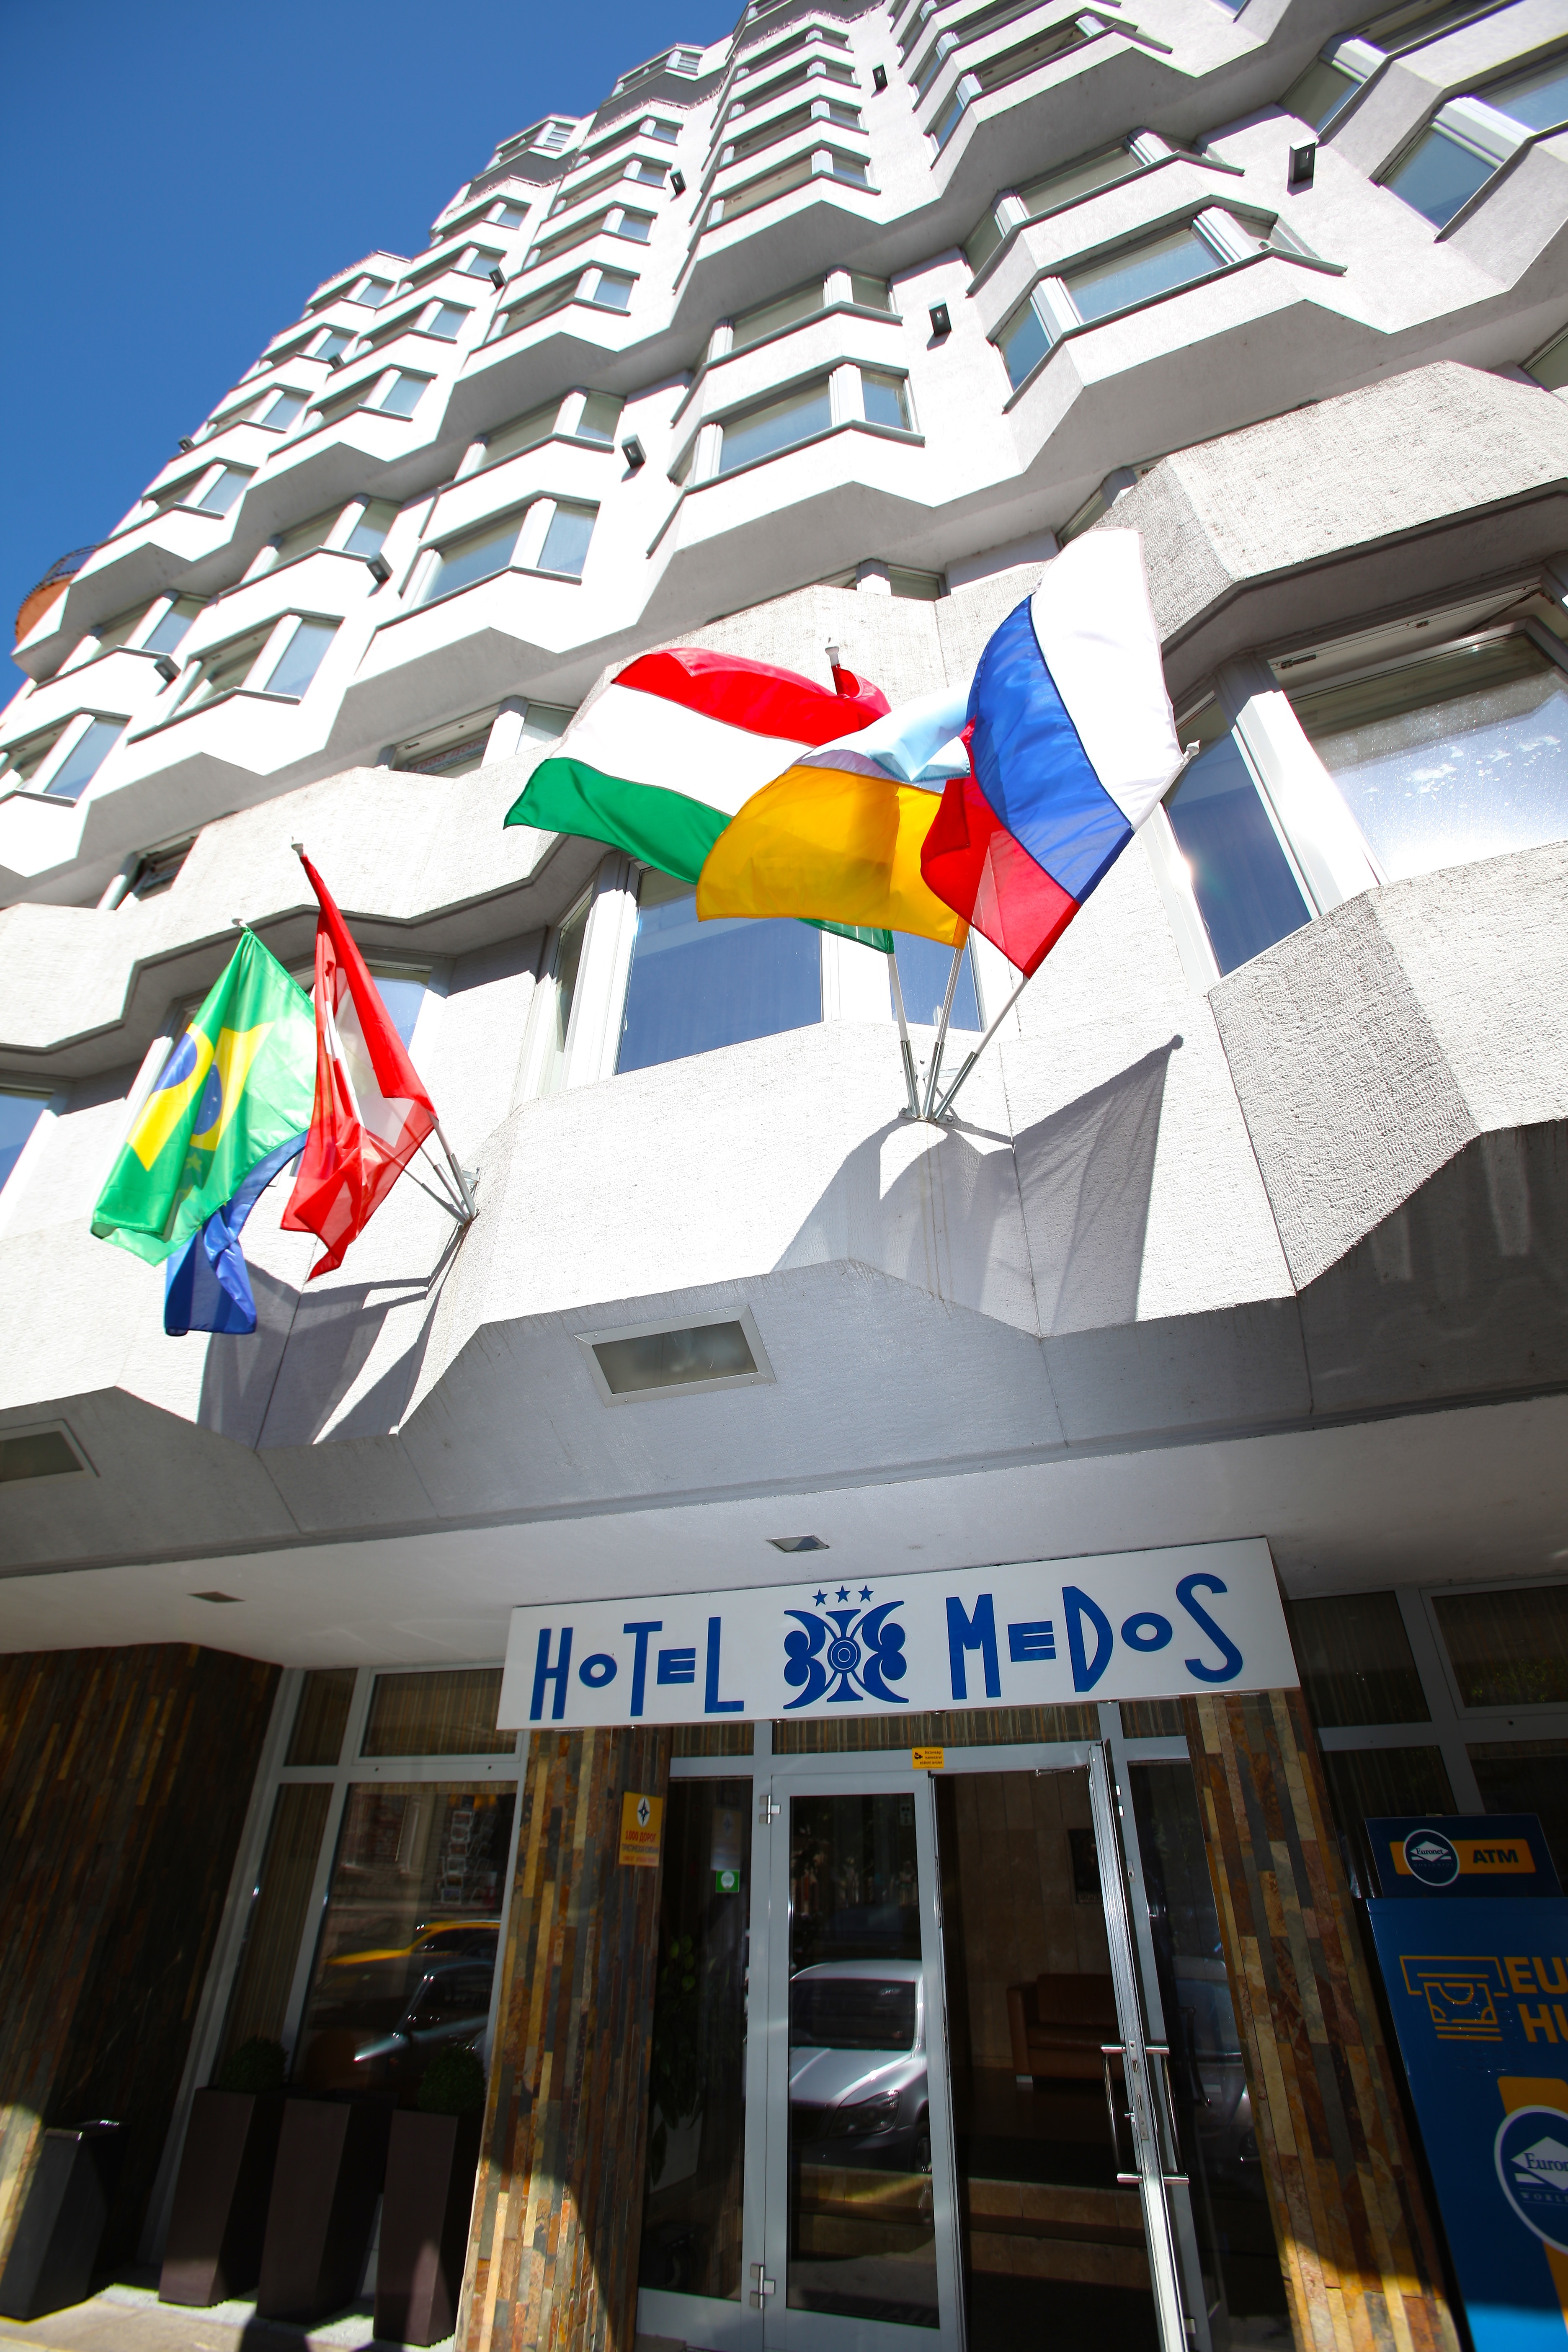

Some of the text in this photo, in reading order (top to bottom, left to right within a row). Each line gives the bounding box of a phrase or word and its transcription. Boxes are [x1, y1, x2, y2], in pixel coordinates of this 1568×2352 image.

[414, 755, 445, 772] 1000
[450, 740, 487, 758] ДОРО
[529, 1573, 1243, 1720] HOTEL MEDOS
[625, 1830, 656, 1843] 1000 ДОРОГ
[1473, 1849, 1519, 1863] ATM
[1504, 1957, 1568, 1994] EU
